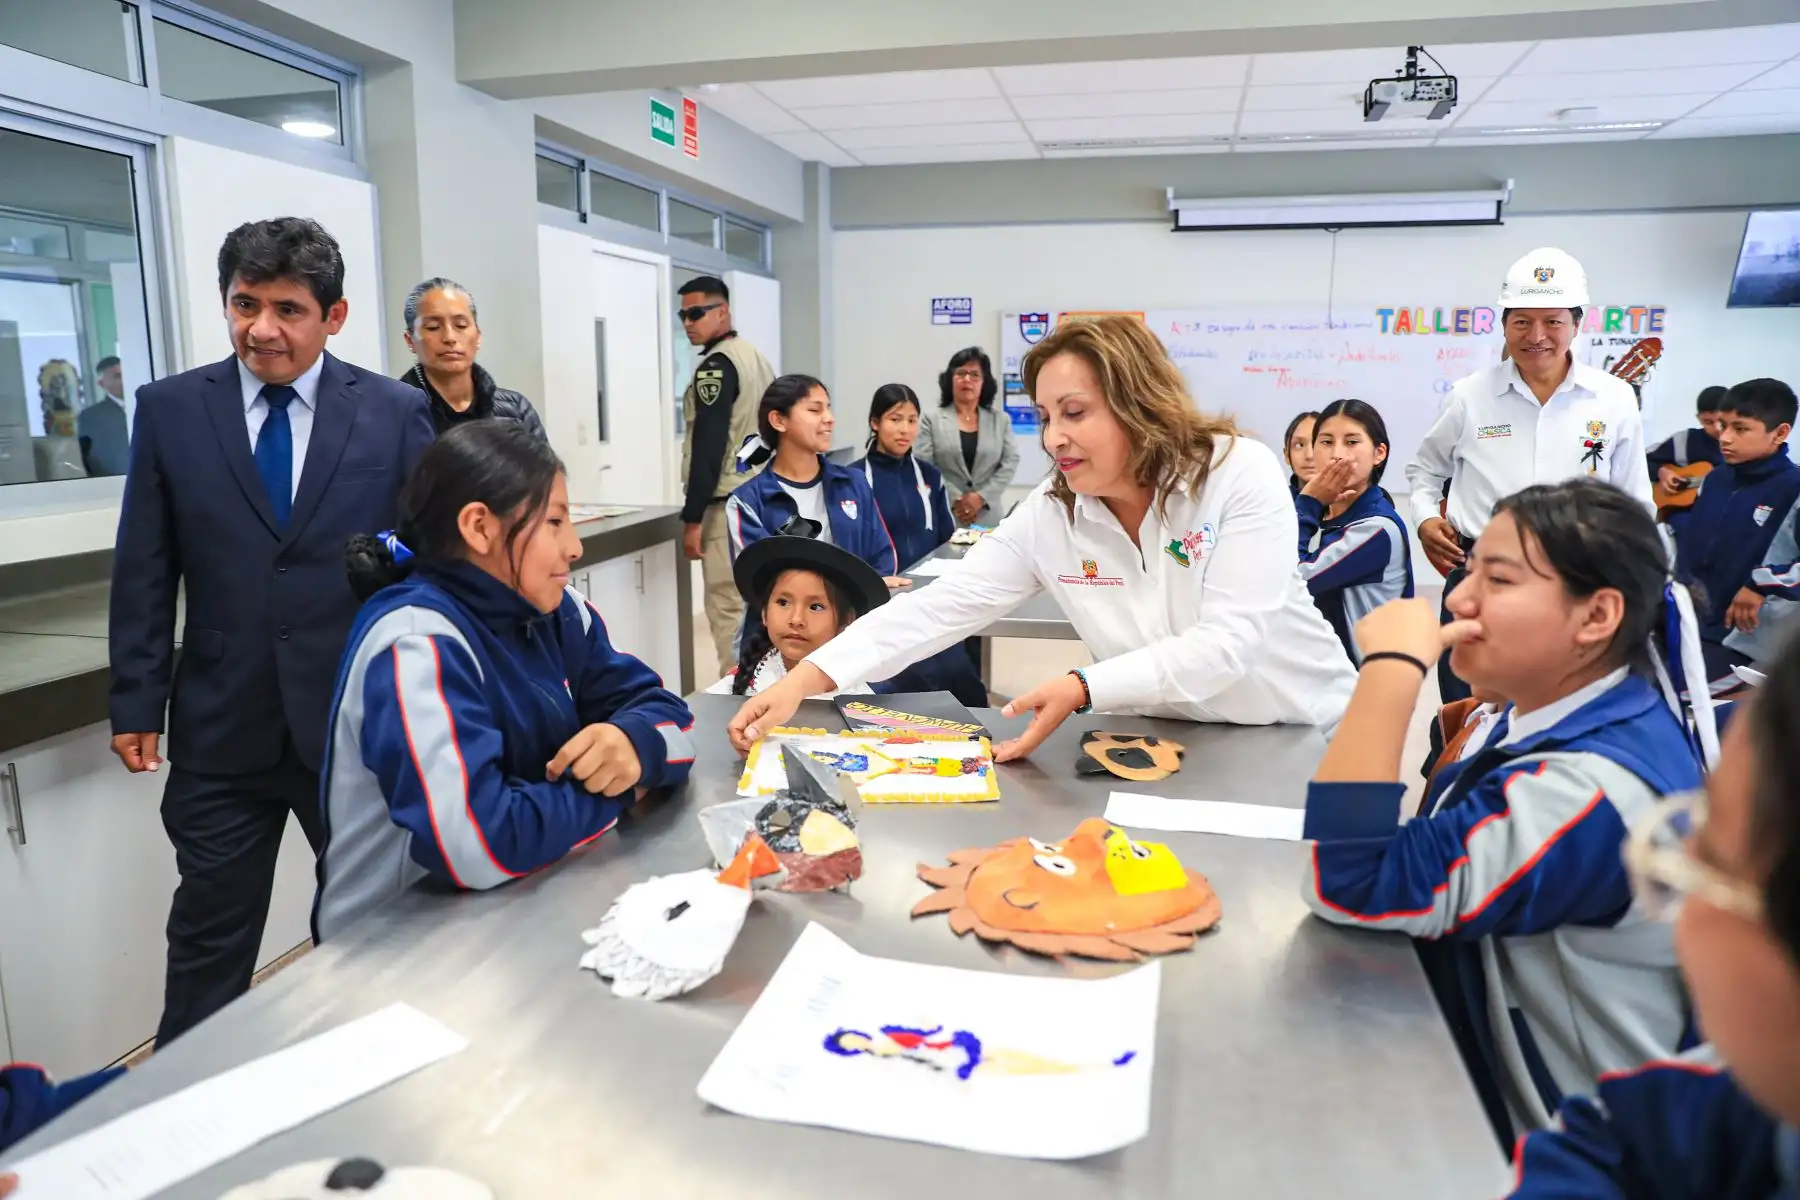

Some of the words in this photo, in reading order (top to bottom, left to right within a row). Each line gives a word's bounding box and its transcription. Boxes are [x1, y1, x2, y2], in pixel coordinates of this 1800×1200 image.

[652, 111, 674, 134] SALIDA
[1520, 287, 1564, 295] LURIGANCHO
[933, 299, 970, 309] AFORO
[1375, 305, 1495, 335] TALLER
[1583, 305, 1665, 334] ARTE
[1591, 337, 1604, 346] LA
